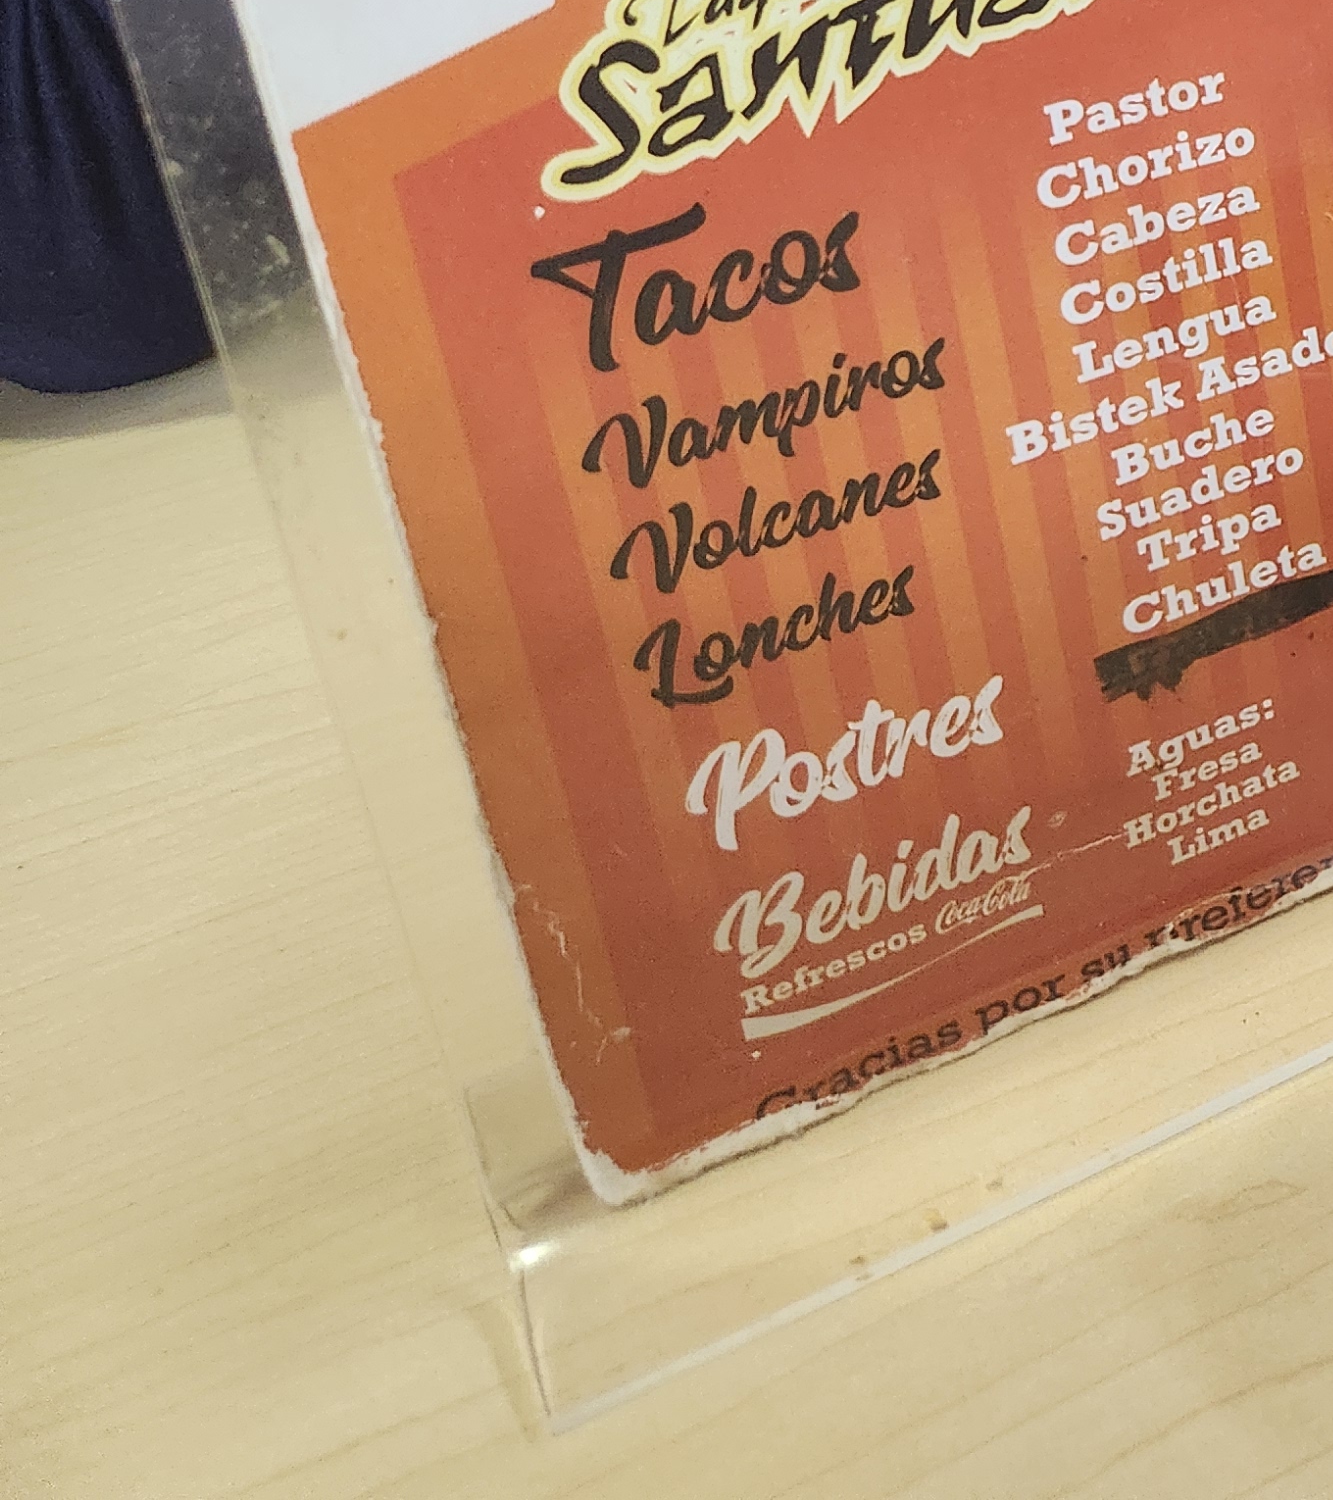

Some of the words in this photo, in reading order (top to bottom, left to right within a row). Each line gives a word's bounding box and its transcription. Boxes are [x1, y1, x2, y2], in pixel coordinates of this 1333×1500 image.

[1043, 72, 1225, 146] Pastor
[1037, 127, 1255, 209] Chorizo
[1055, 185, 1260, 266] Cabeza
[531, 202, 861, 371] Tacos
[1060, 237, 1272, 324] Costilla
[1072, 295, 1276, 383] Lengua
[582, 338, 945, 488] Vampiros
[1006, 378, 1183, 465] Bistek
[1111, 408, 1275, 485] Buche
[610, 449, 942, 593] Volcanes
[1097, 447, 1304, 540] Suadero
[1137, 503, 1281, 571] Tripa
[1122, 542, 1327, 632] Chuleta
[633, 564, 915, 708] Lonches
[685, 675, 1003, 850] Postres
[1126, 699, 1275, 777] Aguas:
[1152, 743, 1261, 800] Fresa
[1123, 760, 1300, 847] Horchata
[1167, 808, 1269, 865] Lima
[713, 805, 1031, 979] Bebidas
[740, 923, 927, 1014] Refrescos
[975, 973, 1068, 1035] por
[1080, 944, 1131, 984] su
